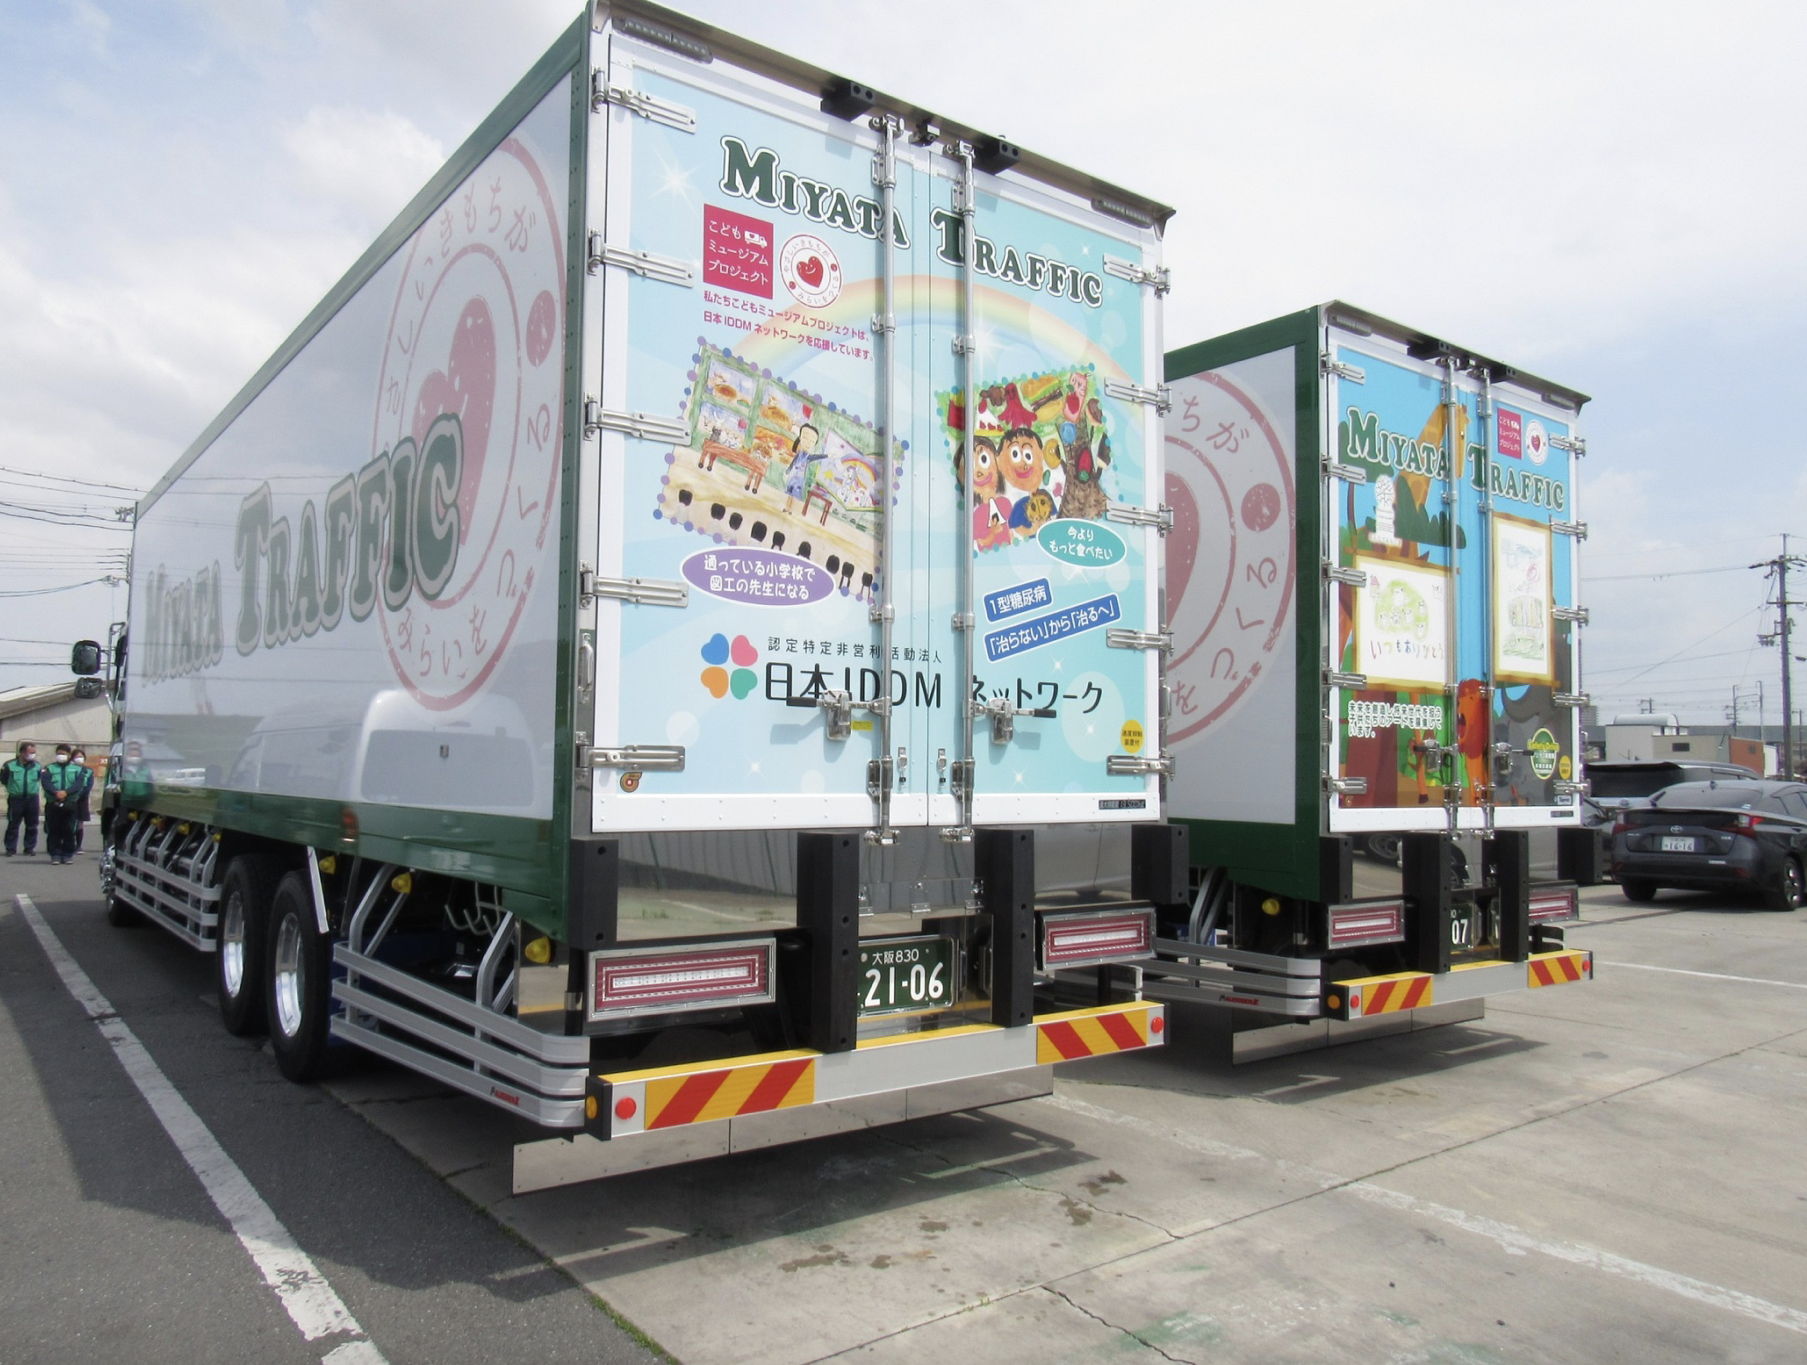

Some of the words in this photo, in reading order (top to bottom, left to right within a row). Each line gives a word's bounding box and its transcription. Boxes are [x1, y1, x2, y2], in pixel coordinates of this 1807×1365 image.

[709, 220, 741, 240] こども
[719, 135, 911, 249] MIYATA
[931, 206, 1103, 308] TRAFFIC
[709, 239, 769, 266] ミュージアム
[709, 260, 768, 286] プロジェクト
[704, 290, 870, 341] 私たちこどもミュージアムプロジェクトは、
[1347, 406, 1450, 482] MIYATA
[1467, 443, 1565, 512] TRAFFIC
[236, 412, 463, 656] TRAFFIC
[1068, 526, 1094, 541] 今より
[1049, 540, 1113, 560] もっと食べたい
[704, 555, 816, 582] 通っている小学校で
[710, 575, 809, 600] 図工の先生になる
[989, 585, 1047, 614] 1型糖尿病
[768, 637, 942, 663] 認定特定非営利活動法人
[864, 962, 944, 1008] 21-06
